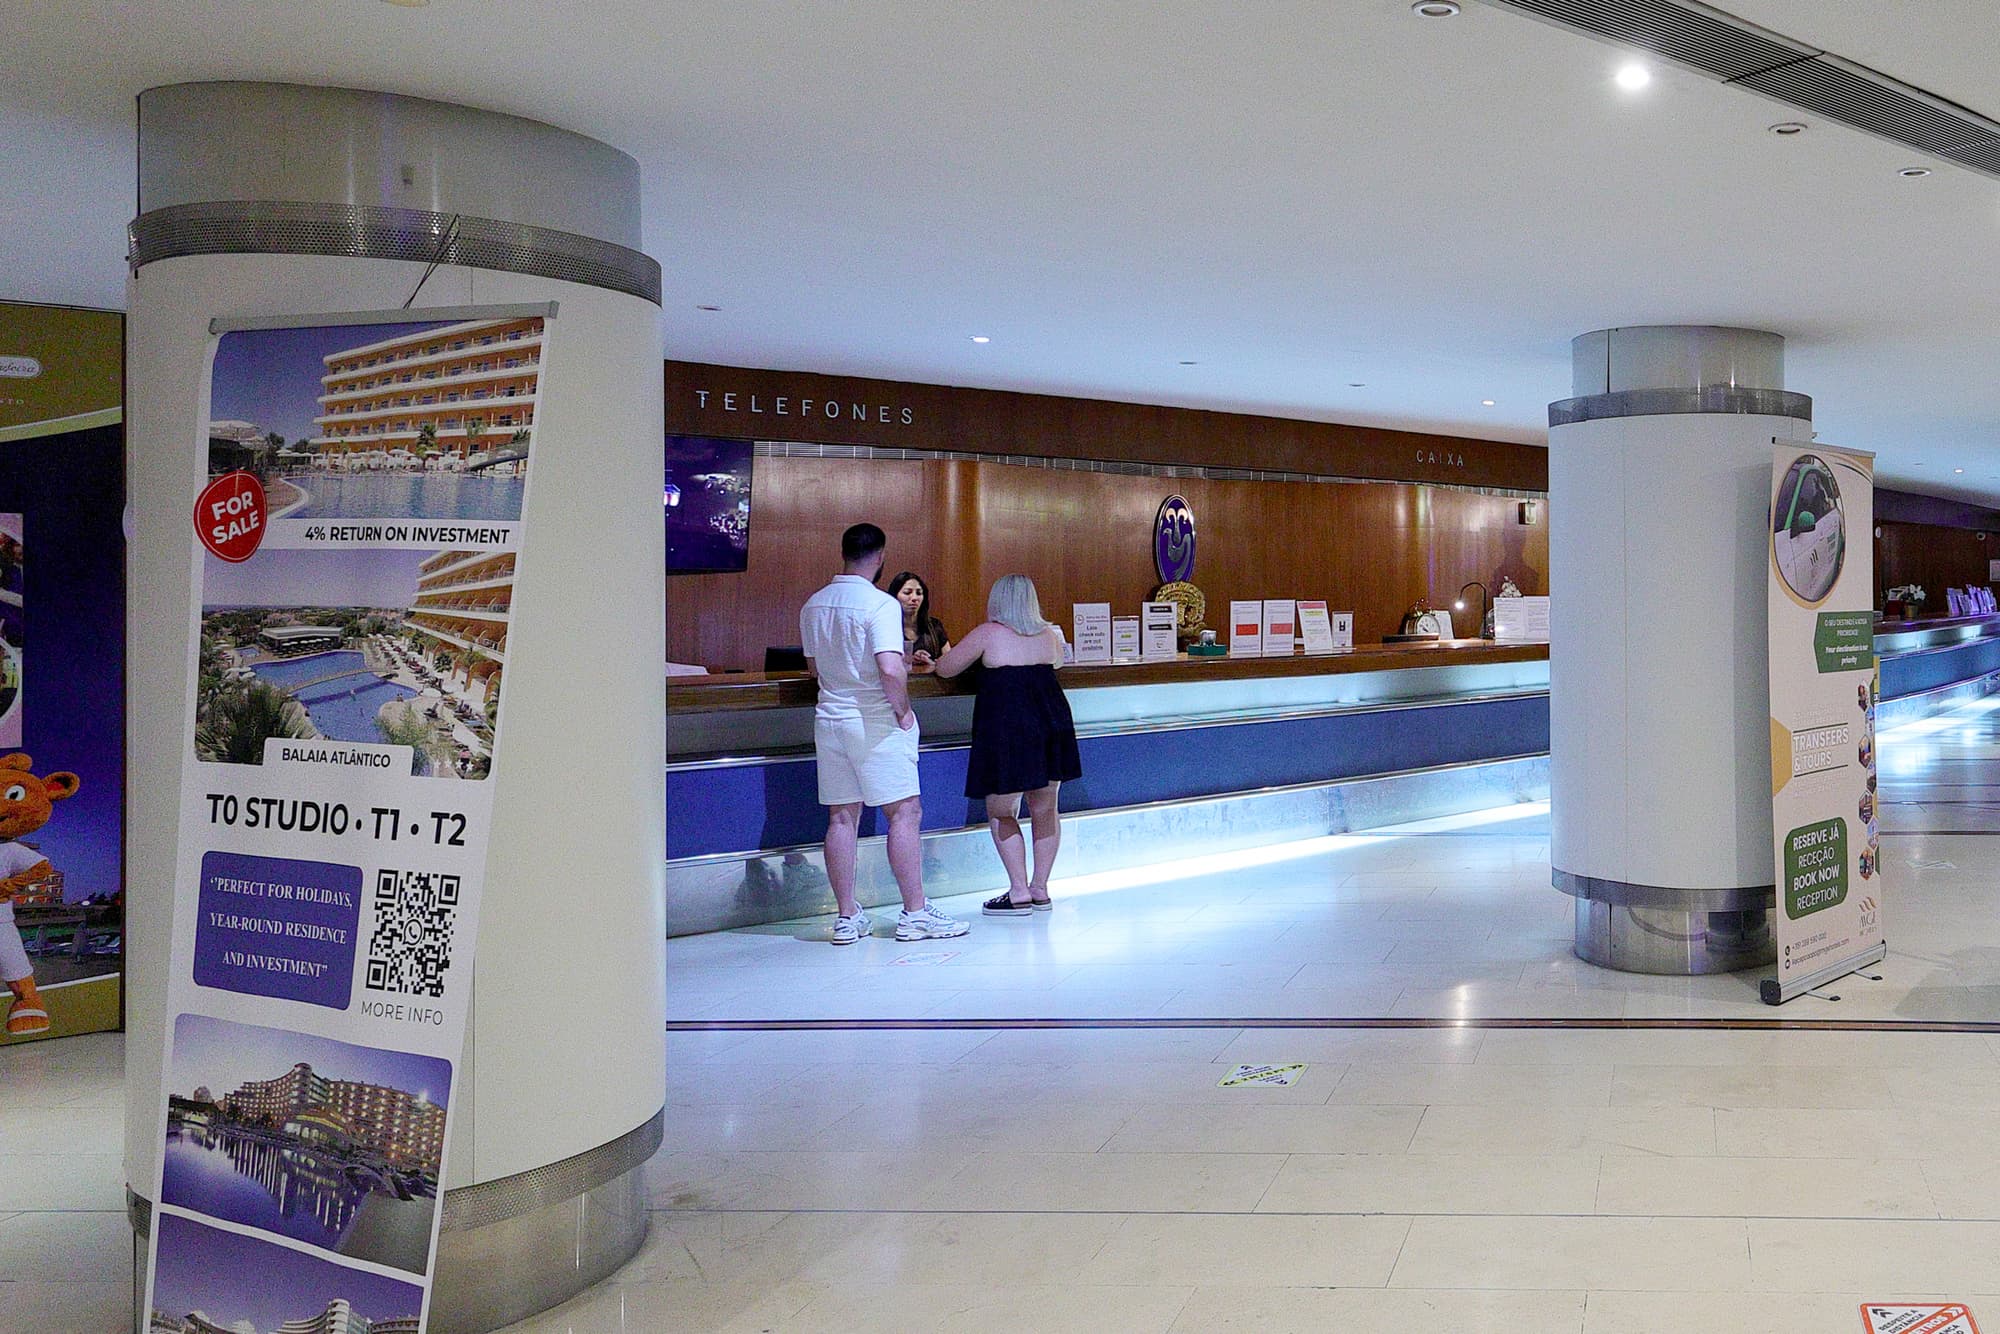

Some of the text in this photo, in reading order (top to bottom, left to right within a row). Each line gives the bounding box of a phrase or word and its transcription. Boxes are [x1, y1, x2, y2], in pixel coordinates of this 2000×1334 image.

[696, 390, 913, 425] TELEFONES
[1416, 449, 1464, 467] CAIXA
[211, 491, 254, 521] FOR
[211, 510, 260, 545] SALE
[304, 526, 510, 544] 4% RETURN ON INVESTMENT
[1793, 727, 1849, 753] TRANSFERS
[282, 748, 391, 768] BALAIA ATLÂNTICO
[1793, 750, 1832, 773] & TOURS
[245, 797, 349, 835] STUDIO
[371, 807, 400, 841] T1
[431, 812, 467, 846] T2
[1793, 822, 1840, 851] RESERVE JÁ
[1798, 847, 1835, 869] RECEÇÃO
[1793, 864, 1840, 892] BOOK NOW
[268, 883, 293, 900] FOR
[296, 887, 353, 908] HOLIDAYS,
[1796, 885, 1838, 911] RECEPTION
[210, 912, 347, 944] YEAR-ROUND RESIDENCE
[222, 951, 245, 967] AND
[361, 1001, 443, 1026] MORE INFO
